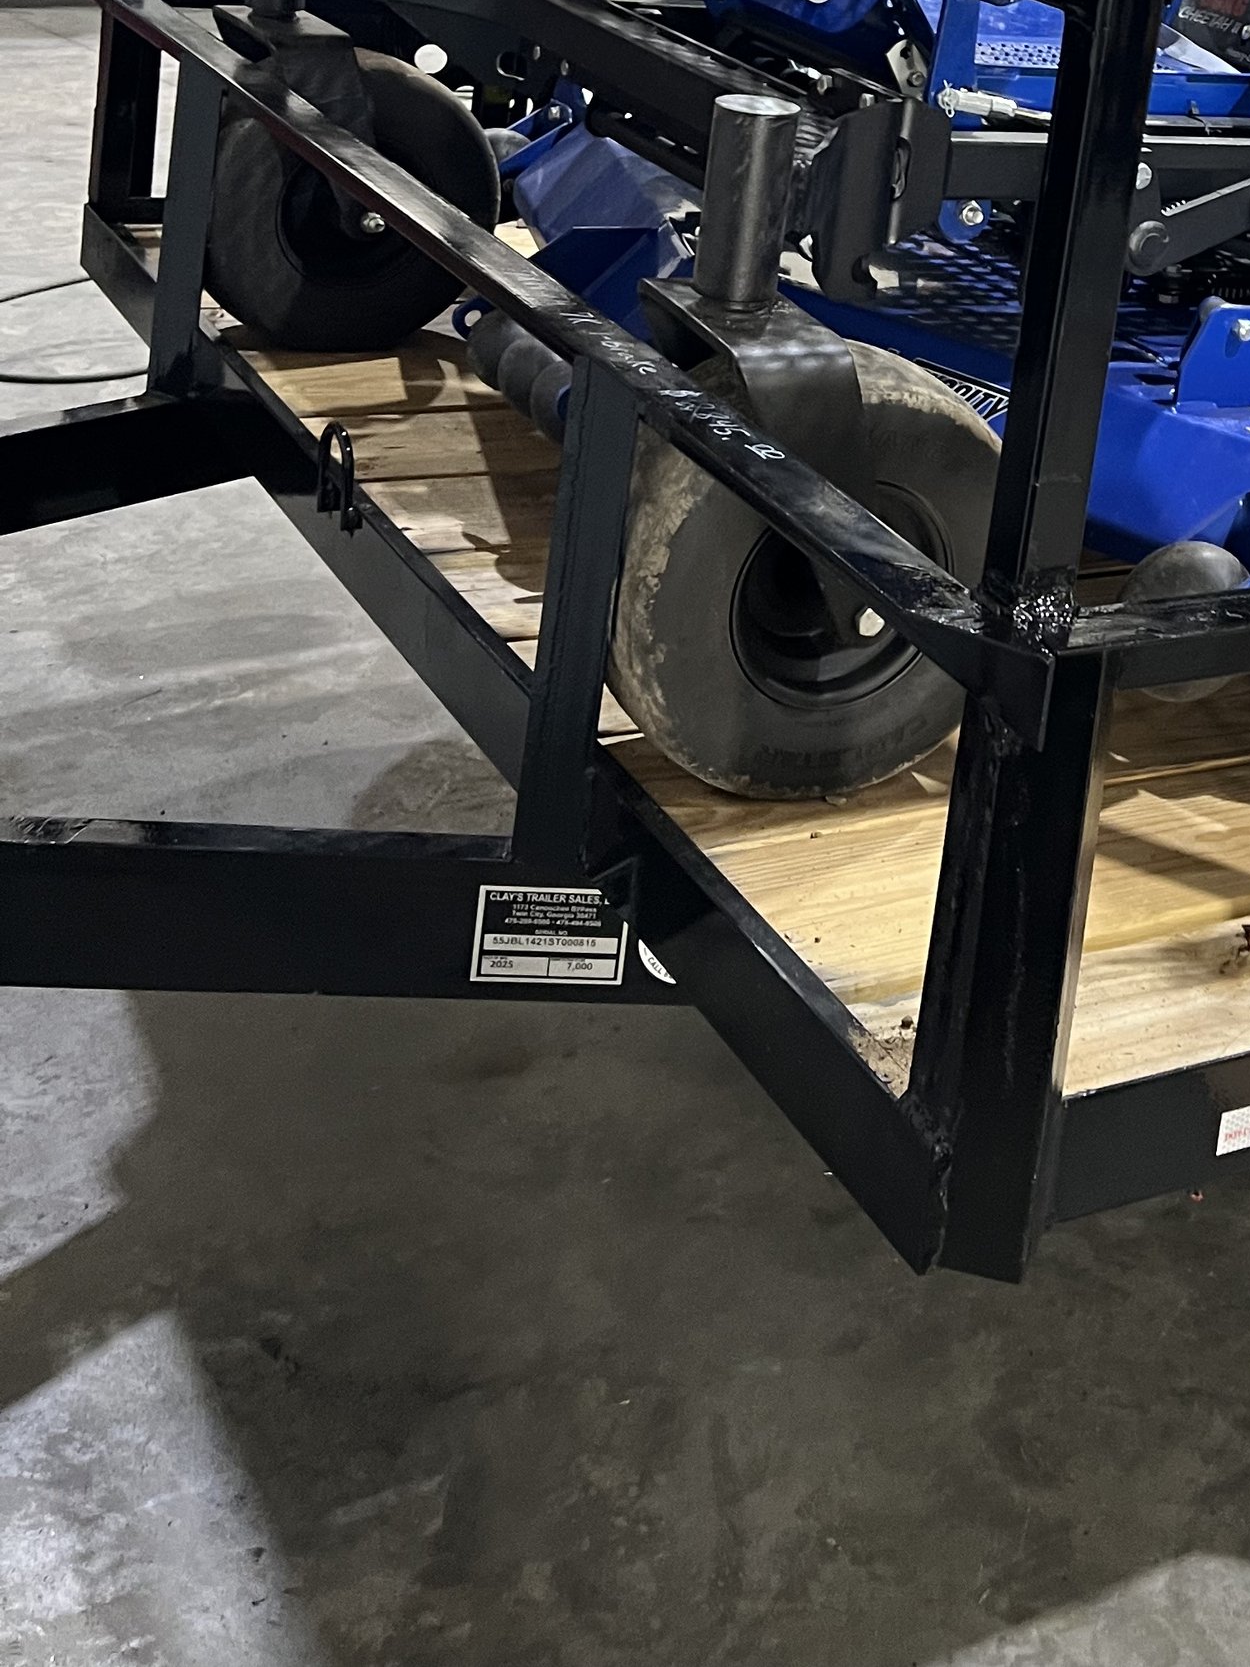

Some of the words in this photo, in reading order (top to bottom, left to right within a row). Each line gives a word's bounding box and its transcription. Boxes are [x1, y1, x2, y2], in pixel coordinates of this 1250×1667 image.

[489, 892, 524, 902] CLAY'S
[526, 893, 566, 904] TRAILER
[489, 960, 514, 969] 2025
[567, 962, 593, 972] 7,000
